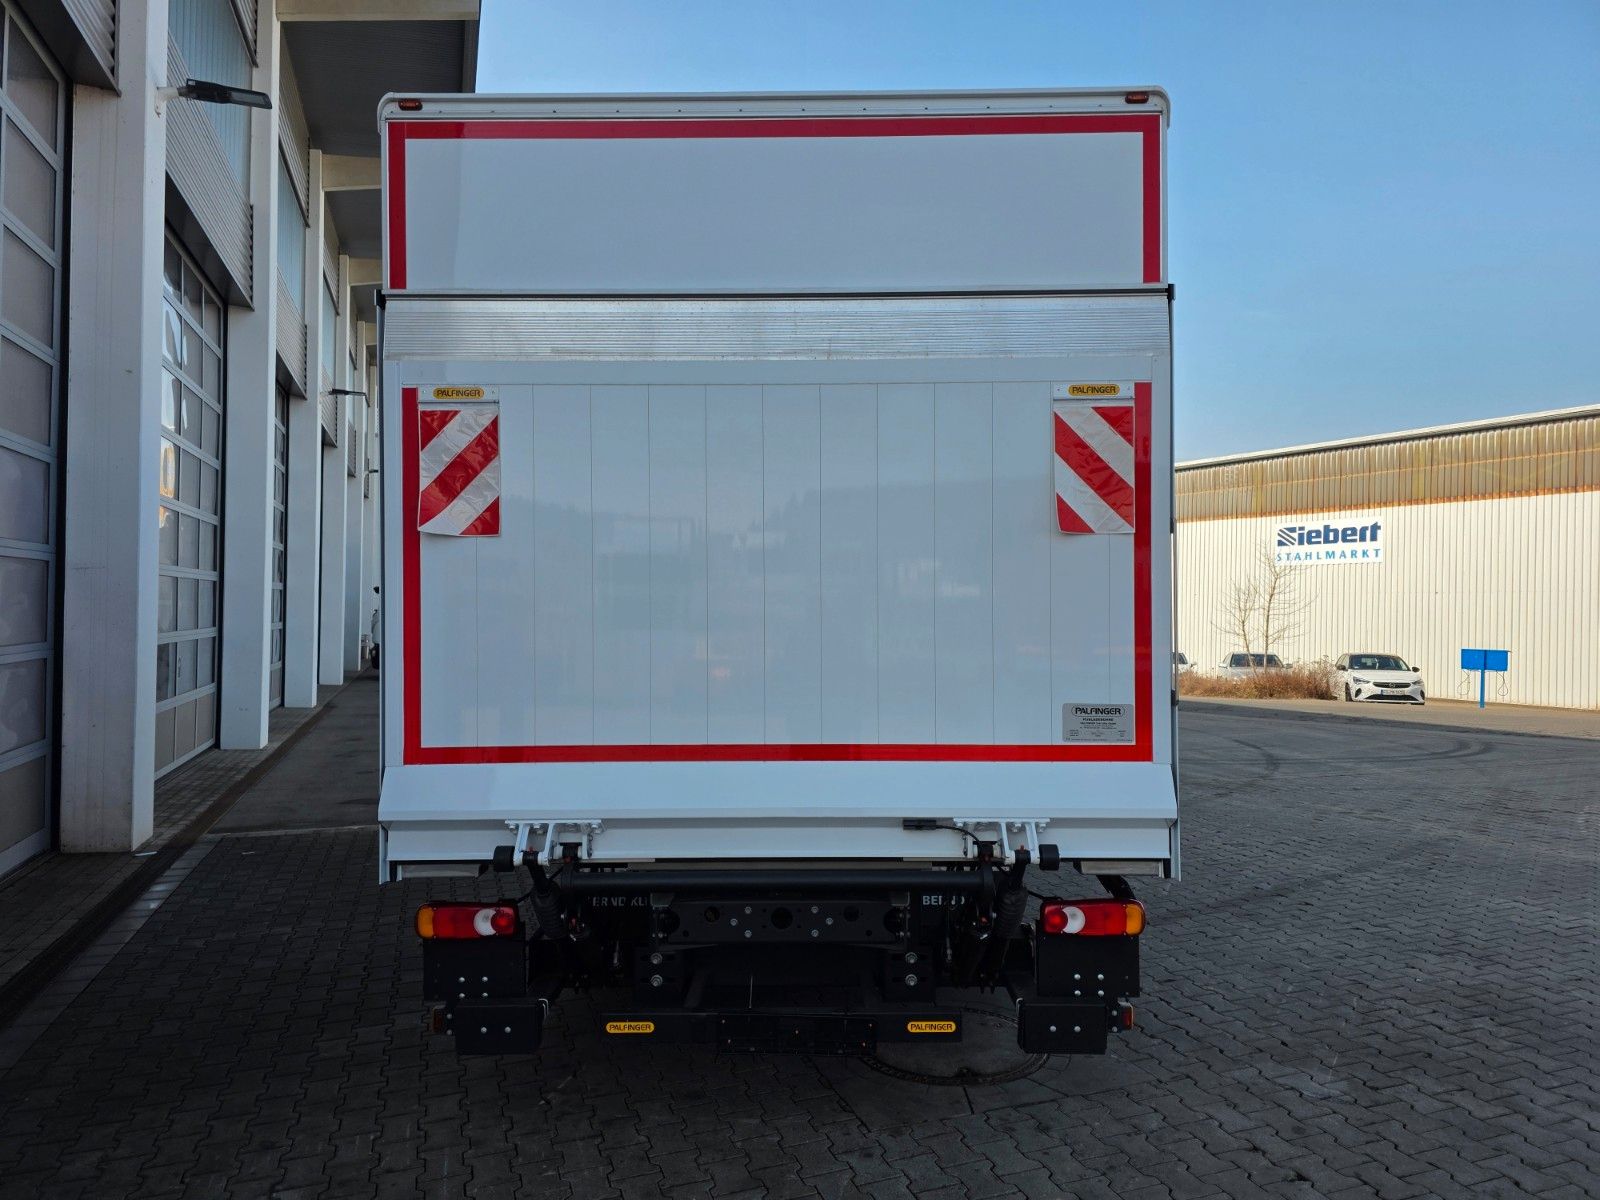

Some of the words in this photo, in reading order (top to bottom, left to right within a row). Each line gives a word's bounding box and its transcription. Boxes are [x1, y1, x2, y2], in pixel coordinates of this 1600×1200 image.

[436, 389, 480, 397] PALFINGER
[1072, 386, 1116, 394] PALFINGER
[1277, 521, 1381, 547] Siebert
[1277, 549, 1381, 562] STAHLMARKT
[1075, 707, 1121, 715] PALFINGER
[910, 1023, 953, 1031] PALFINGER
